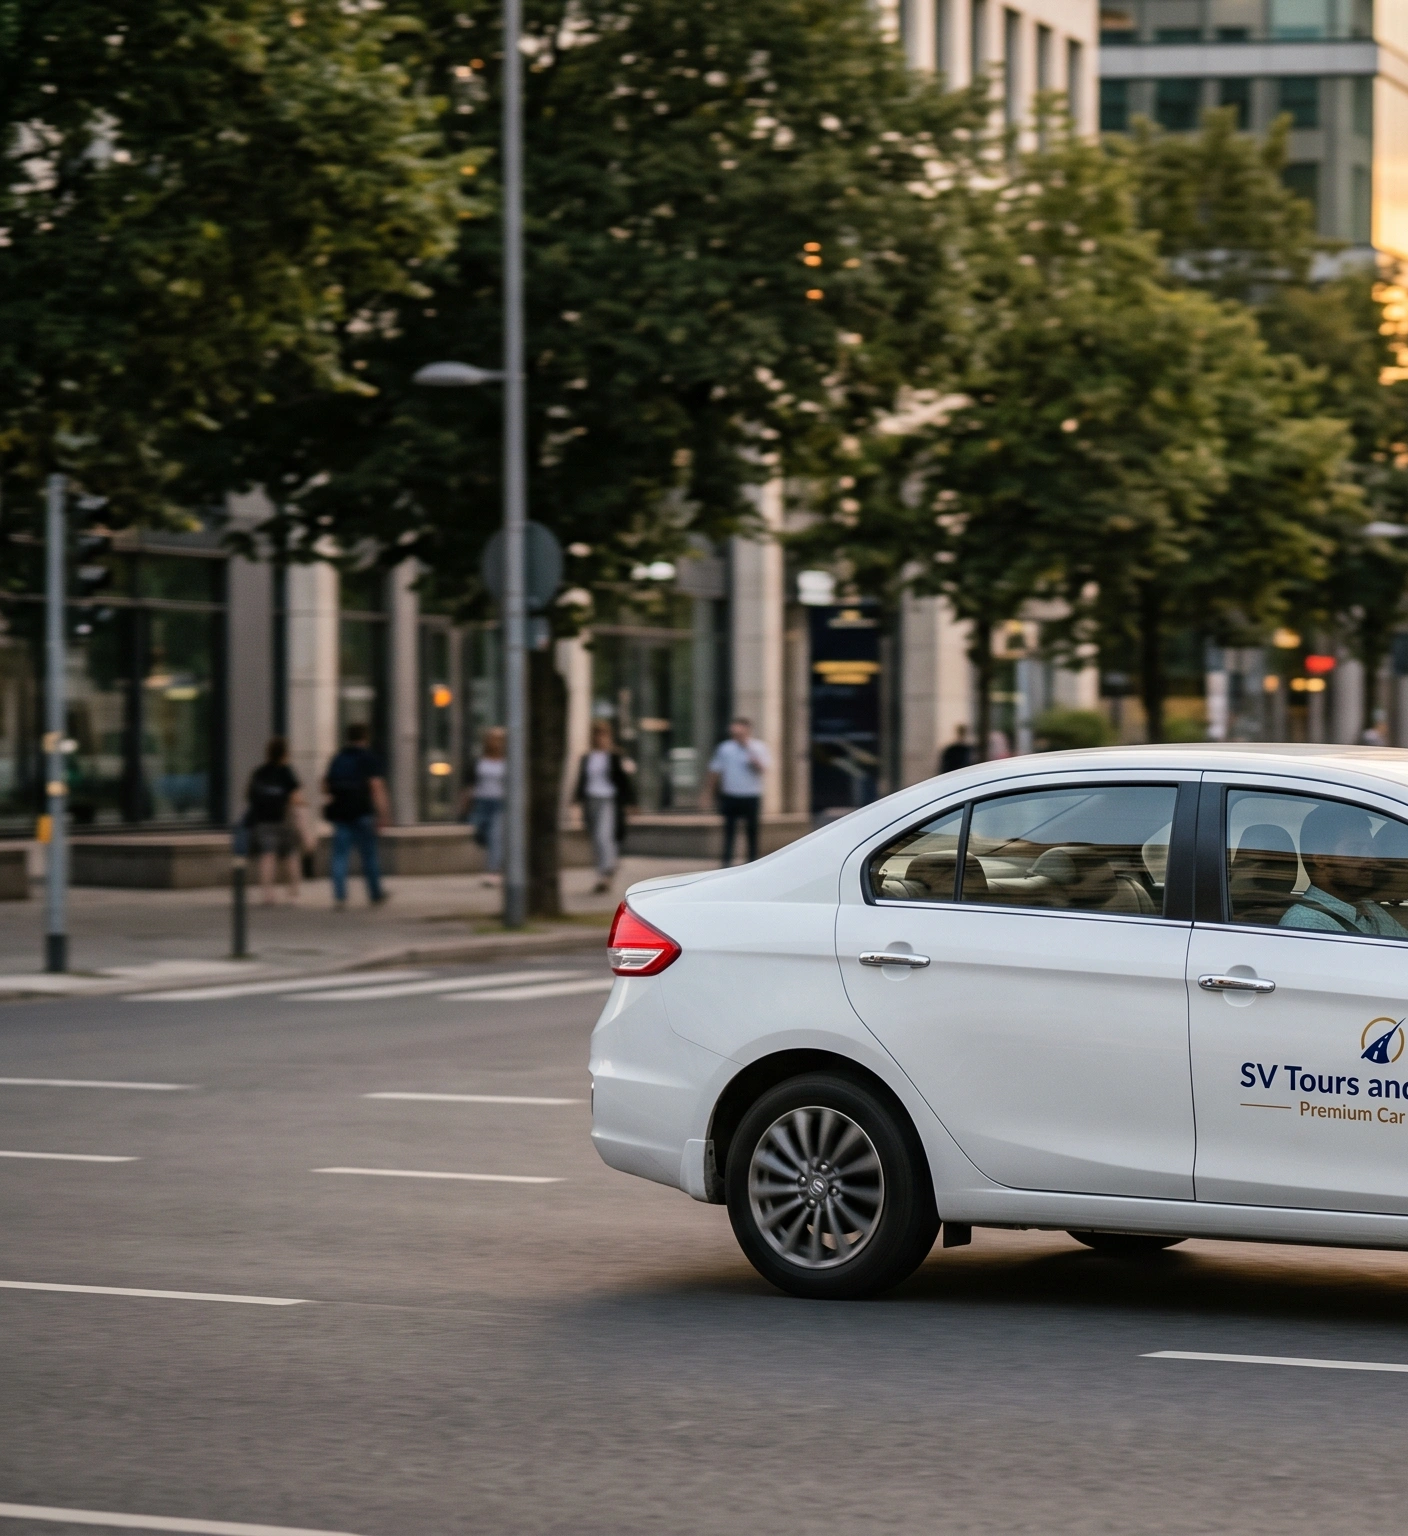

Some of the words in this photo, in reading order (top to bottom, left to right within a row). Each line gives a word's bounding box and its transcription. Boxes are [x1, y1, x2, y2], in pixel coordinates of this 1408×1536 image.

[1240, 1062, 1278, 1089] SV
[1284, 1065, 1360, 1096] Tours
[1300, 1101, 1373, 1122] Premium
[1377, 1107, 1406, 1125] Car
